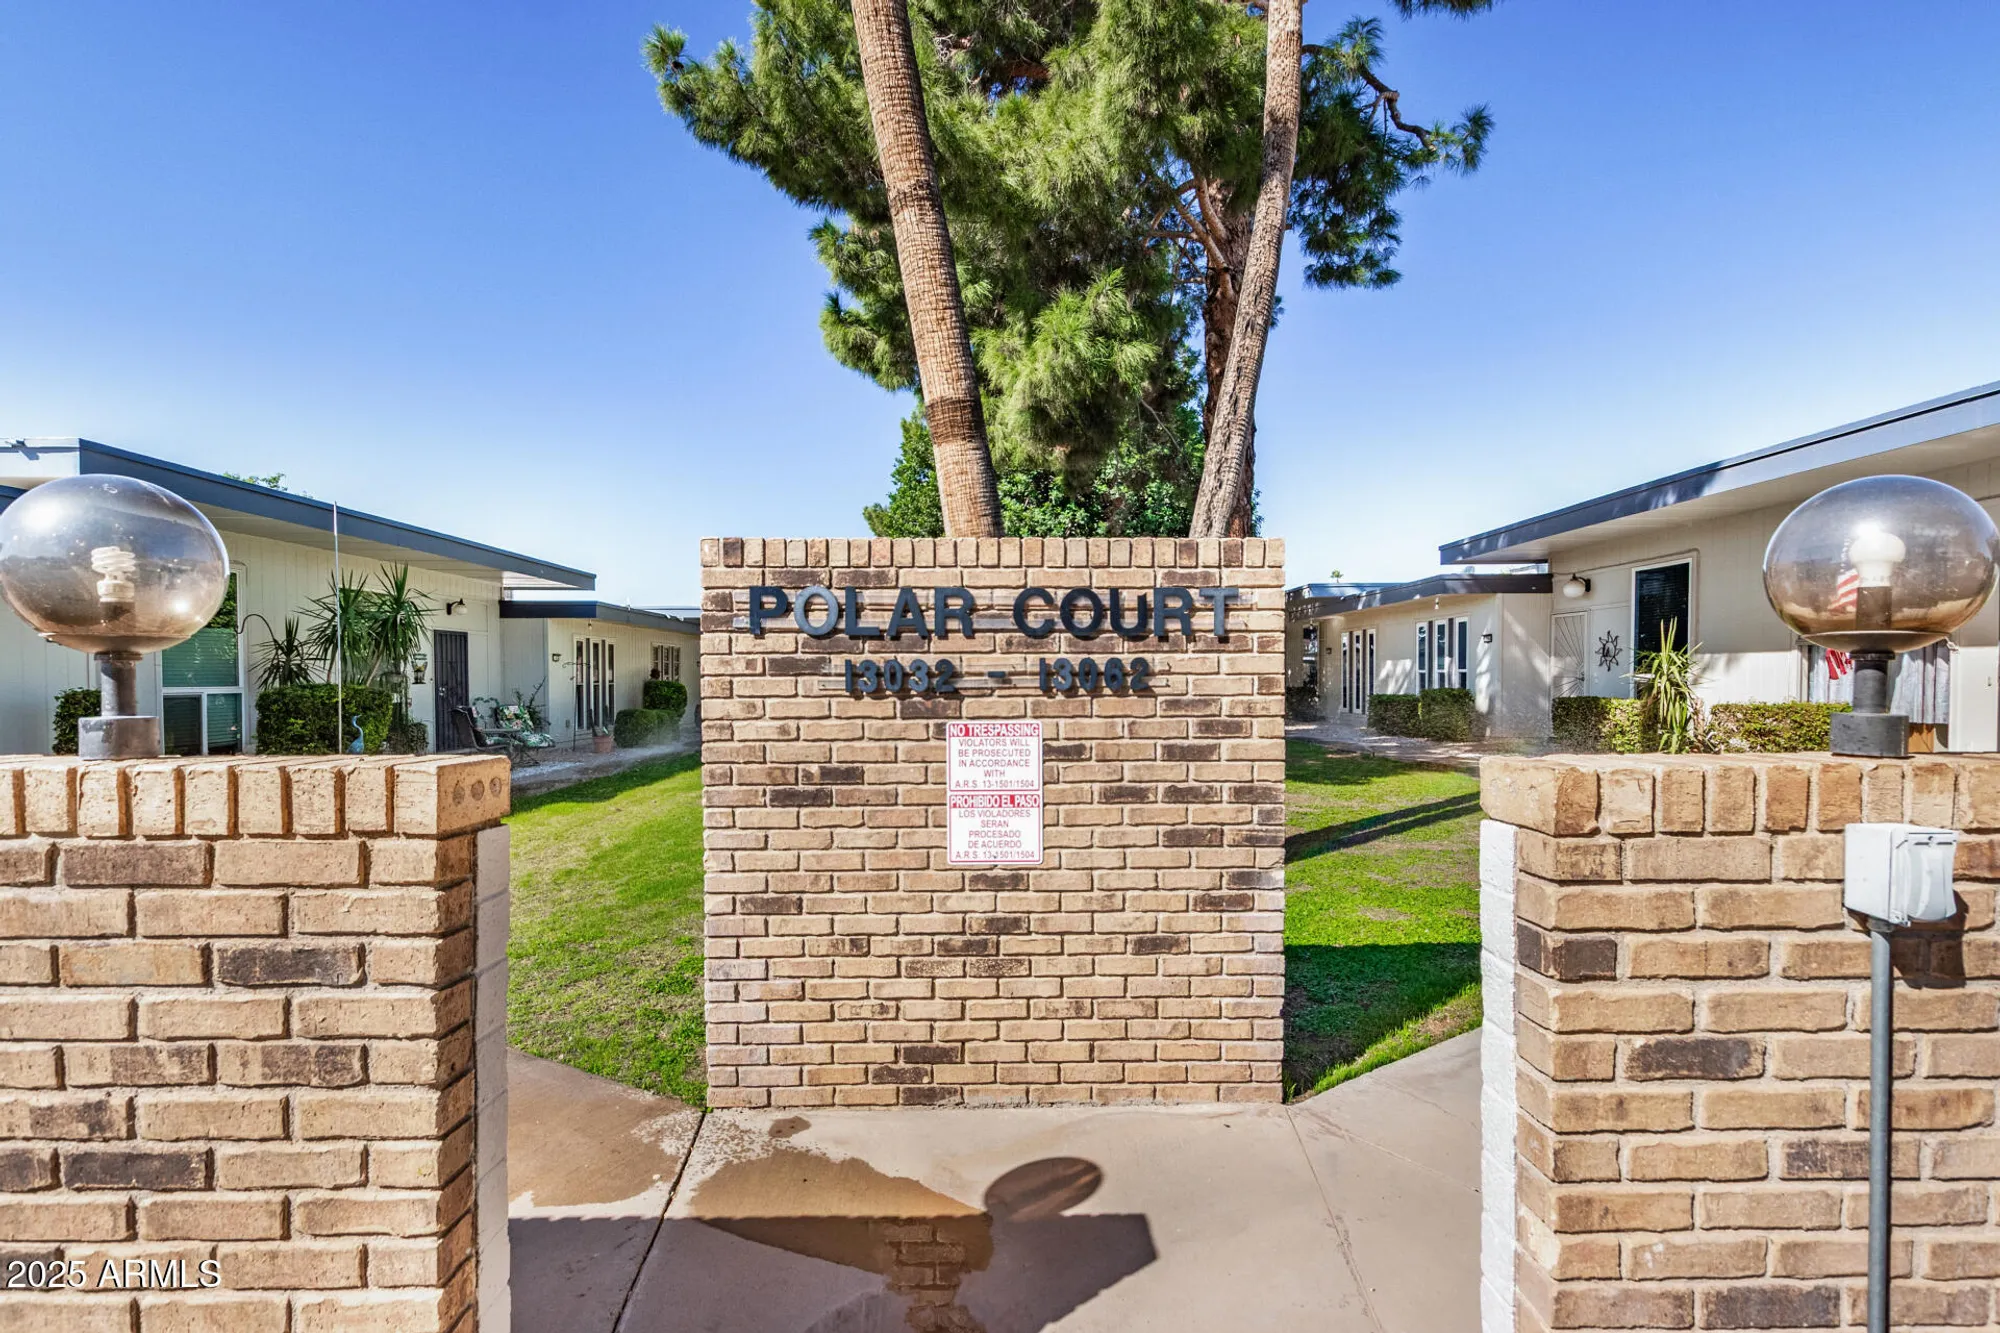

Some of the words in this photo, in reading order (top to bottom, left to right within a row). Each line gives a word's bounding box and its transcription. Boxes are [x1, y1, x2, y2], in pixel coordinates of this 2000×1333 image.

[748, 585, 976, 638] POLAR
[1013, 586, 1240, 638] COURT
[845, 658, 956, 693] 13032
[951, 724, 965, 736] NO
[968, 724, 1039, 736] TRESPASSING
[959, 739, 1007, 747] VIOLATORS
[1009, 739, 1030, 747] WILL
[958, 749, 970, 757] BE
[972, 749, 1031, 757] PROSECUTED
[958, 759, 967, 767] IN
[969, 759, 1030, 767] ACCORDANCE
[984, 769, 1005, 777] WITH
[951, 795, 999, 807] PROHIBIDO
[1000, 795, 1013, 807] EL
[1015, 795, 1039, 807] PASO
[958, 810, 976, 818] LOS
[978, 810, 1031, 818] VIOLADORES
[980, 820, 1008, 828] SERAN
[969, 830, 1021, 838] PROCESADO
